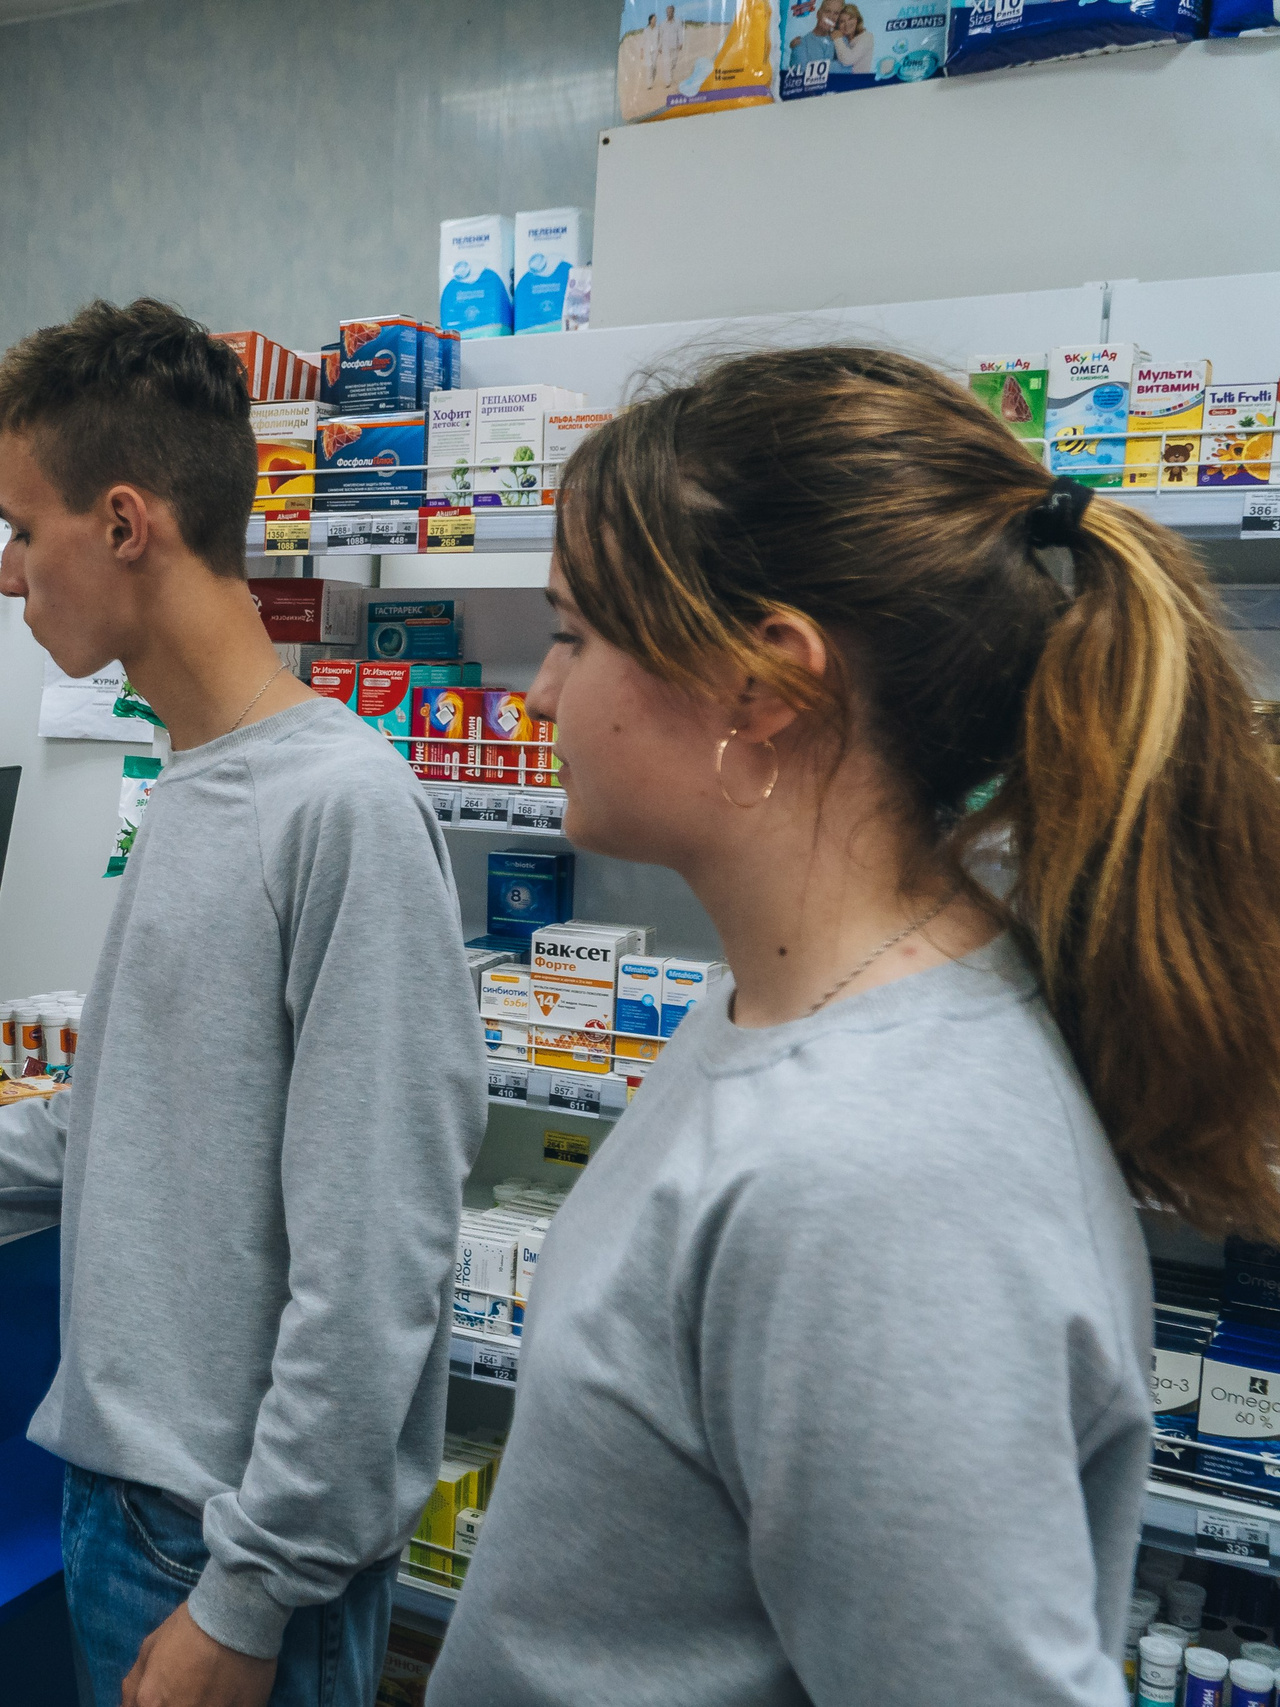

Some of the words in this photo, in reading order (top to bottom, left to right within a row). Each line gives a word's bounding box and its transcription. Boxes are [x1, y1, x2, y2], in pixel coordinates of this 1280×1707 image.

[969, 13, 993, 28] Size
[996, 7, 1022, 18] Pants
[887, 19, 908, 31] ECO
[910, 16, 944, 28] PANTS
[786, 64, 804, 79] XL
[809, 60, 828, 76] 10
[783, 76, 804, 88] Size
[1070, 364, 1110, 375] ОМЕГА
[1138, 368, 1193, 382] Мульти
[1136, 381, 1200, 394] витамин
[481, 393, 538, 405] ГЕПАКОМБ
[1209, 391, 1235, 404] Tutti
[1237, 390, 1272, 404] Frutti
[481, 405, 525, 416] артишок
[432, 409, 472, 423] Хофит
[432, 420, 460, 429] детокс
[1249, 506, 1272, 516] 386
[329, 527, 347, 535] 1288
[376, 525, 390, 533] 548
[430, 527, 445, 535] 378
[277, 542, 295, 550] 1088
[346, 537, 364, 546] 1088
[389, 537, 405, 545] 448
[440, 538, 456, 547] 268
[374, 604, 424, 616] ГАСТРАРЕКС
[362, 667, 404, 677] Dr.Изжогин
[464, 800, 479, 808] 264
[517, 806, 532, 815] 168
[479, 812, 494, 821] 211
[532, 819, 548, 828] 132
[534, 941, 611, 963] Бак-сет
[534, 956, 577, 972] Форте
[668, 969, 703, 982] Metabiotic
[482, 986, 528, 998] синбиотик
[503, 997, 528, 1009] бэби
[536, 994, 554, 1007] 14
[498, 1089, 514, 1098] 410
[554, 1087, 570, 1095] 957
[569, 1102, 586, 1111] 611
[478, 1355, 494, 1364] 154
[494, 1370, 510, 1380] 122
[1235, 1411, 1255, 1425] 60
